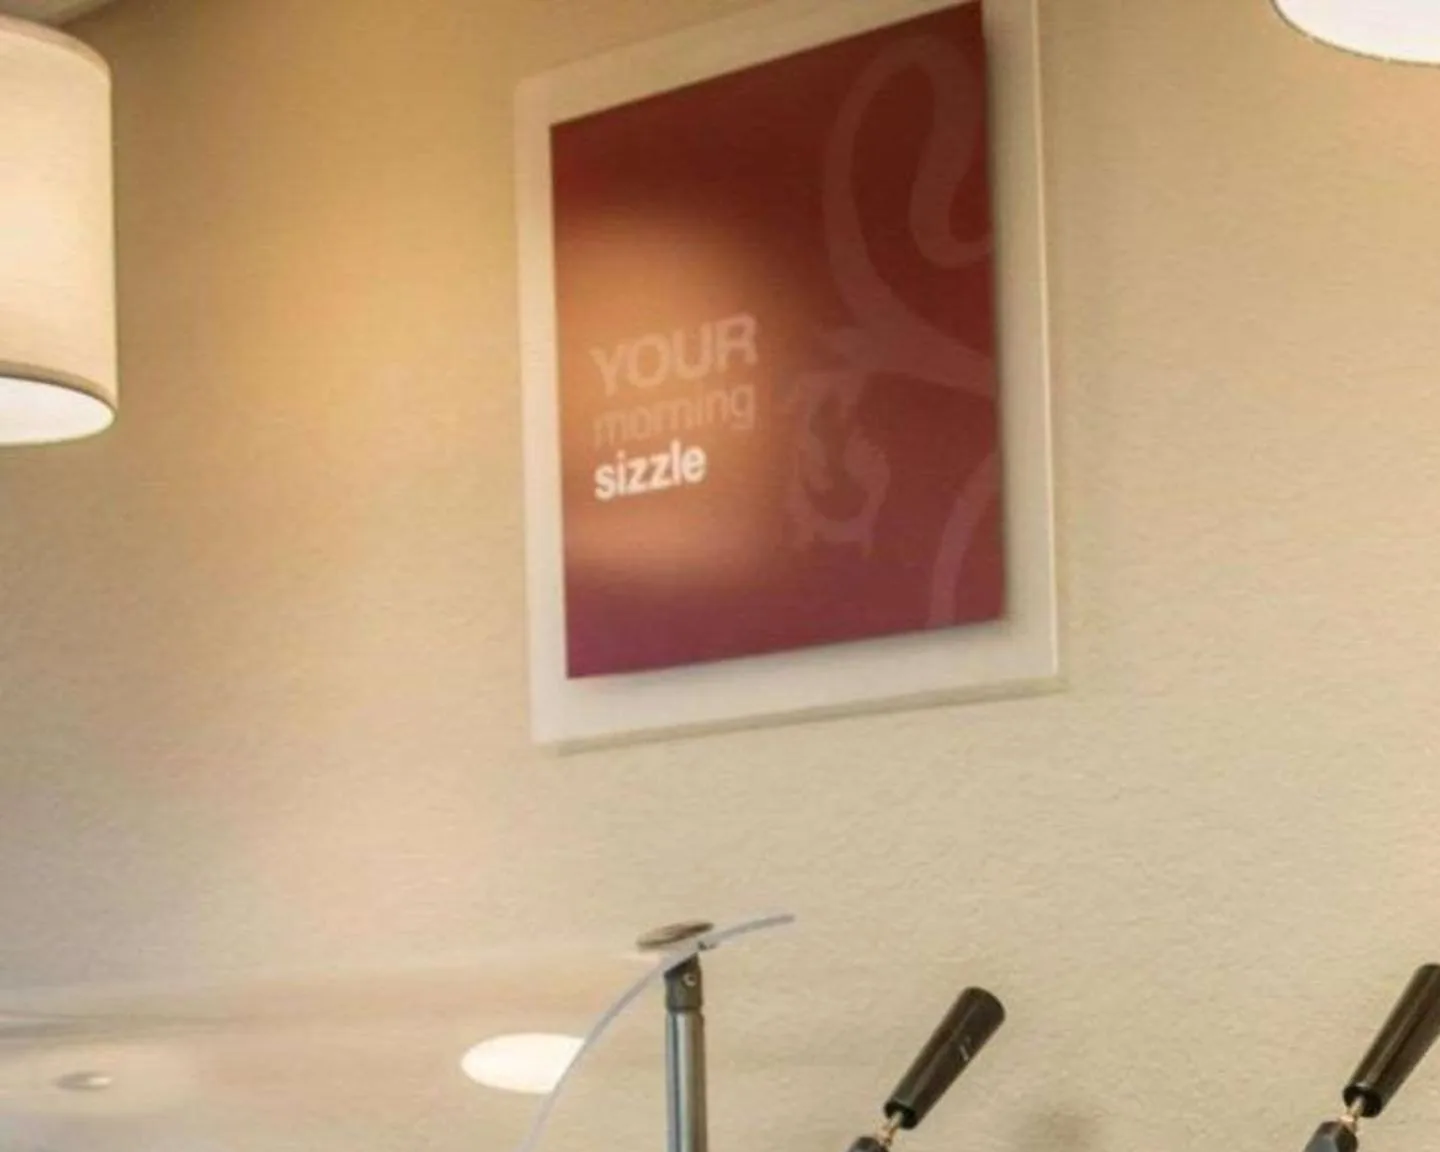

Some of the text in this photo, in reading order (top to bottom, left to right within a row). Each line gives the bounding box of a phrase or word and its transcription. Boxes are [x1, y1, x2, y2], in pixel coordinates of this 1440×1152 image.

[589, 313, 758, 397] YOUR
[594, 383, 756, 445] morning
[593, 438, 707, 501] sizzle
